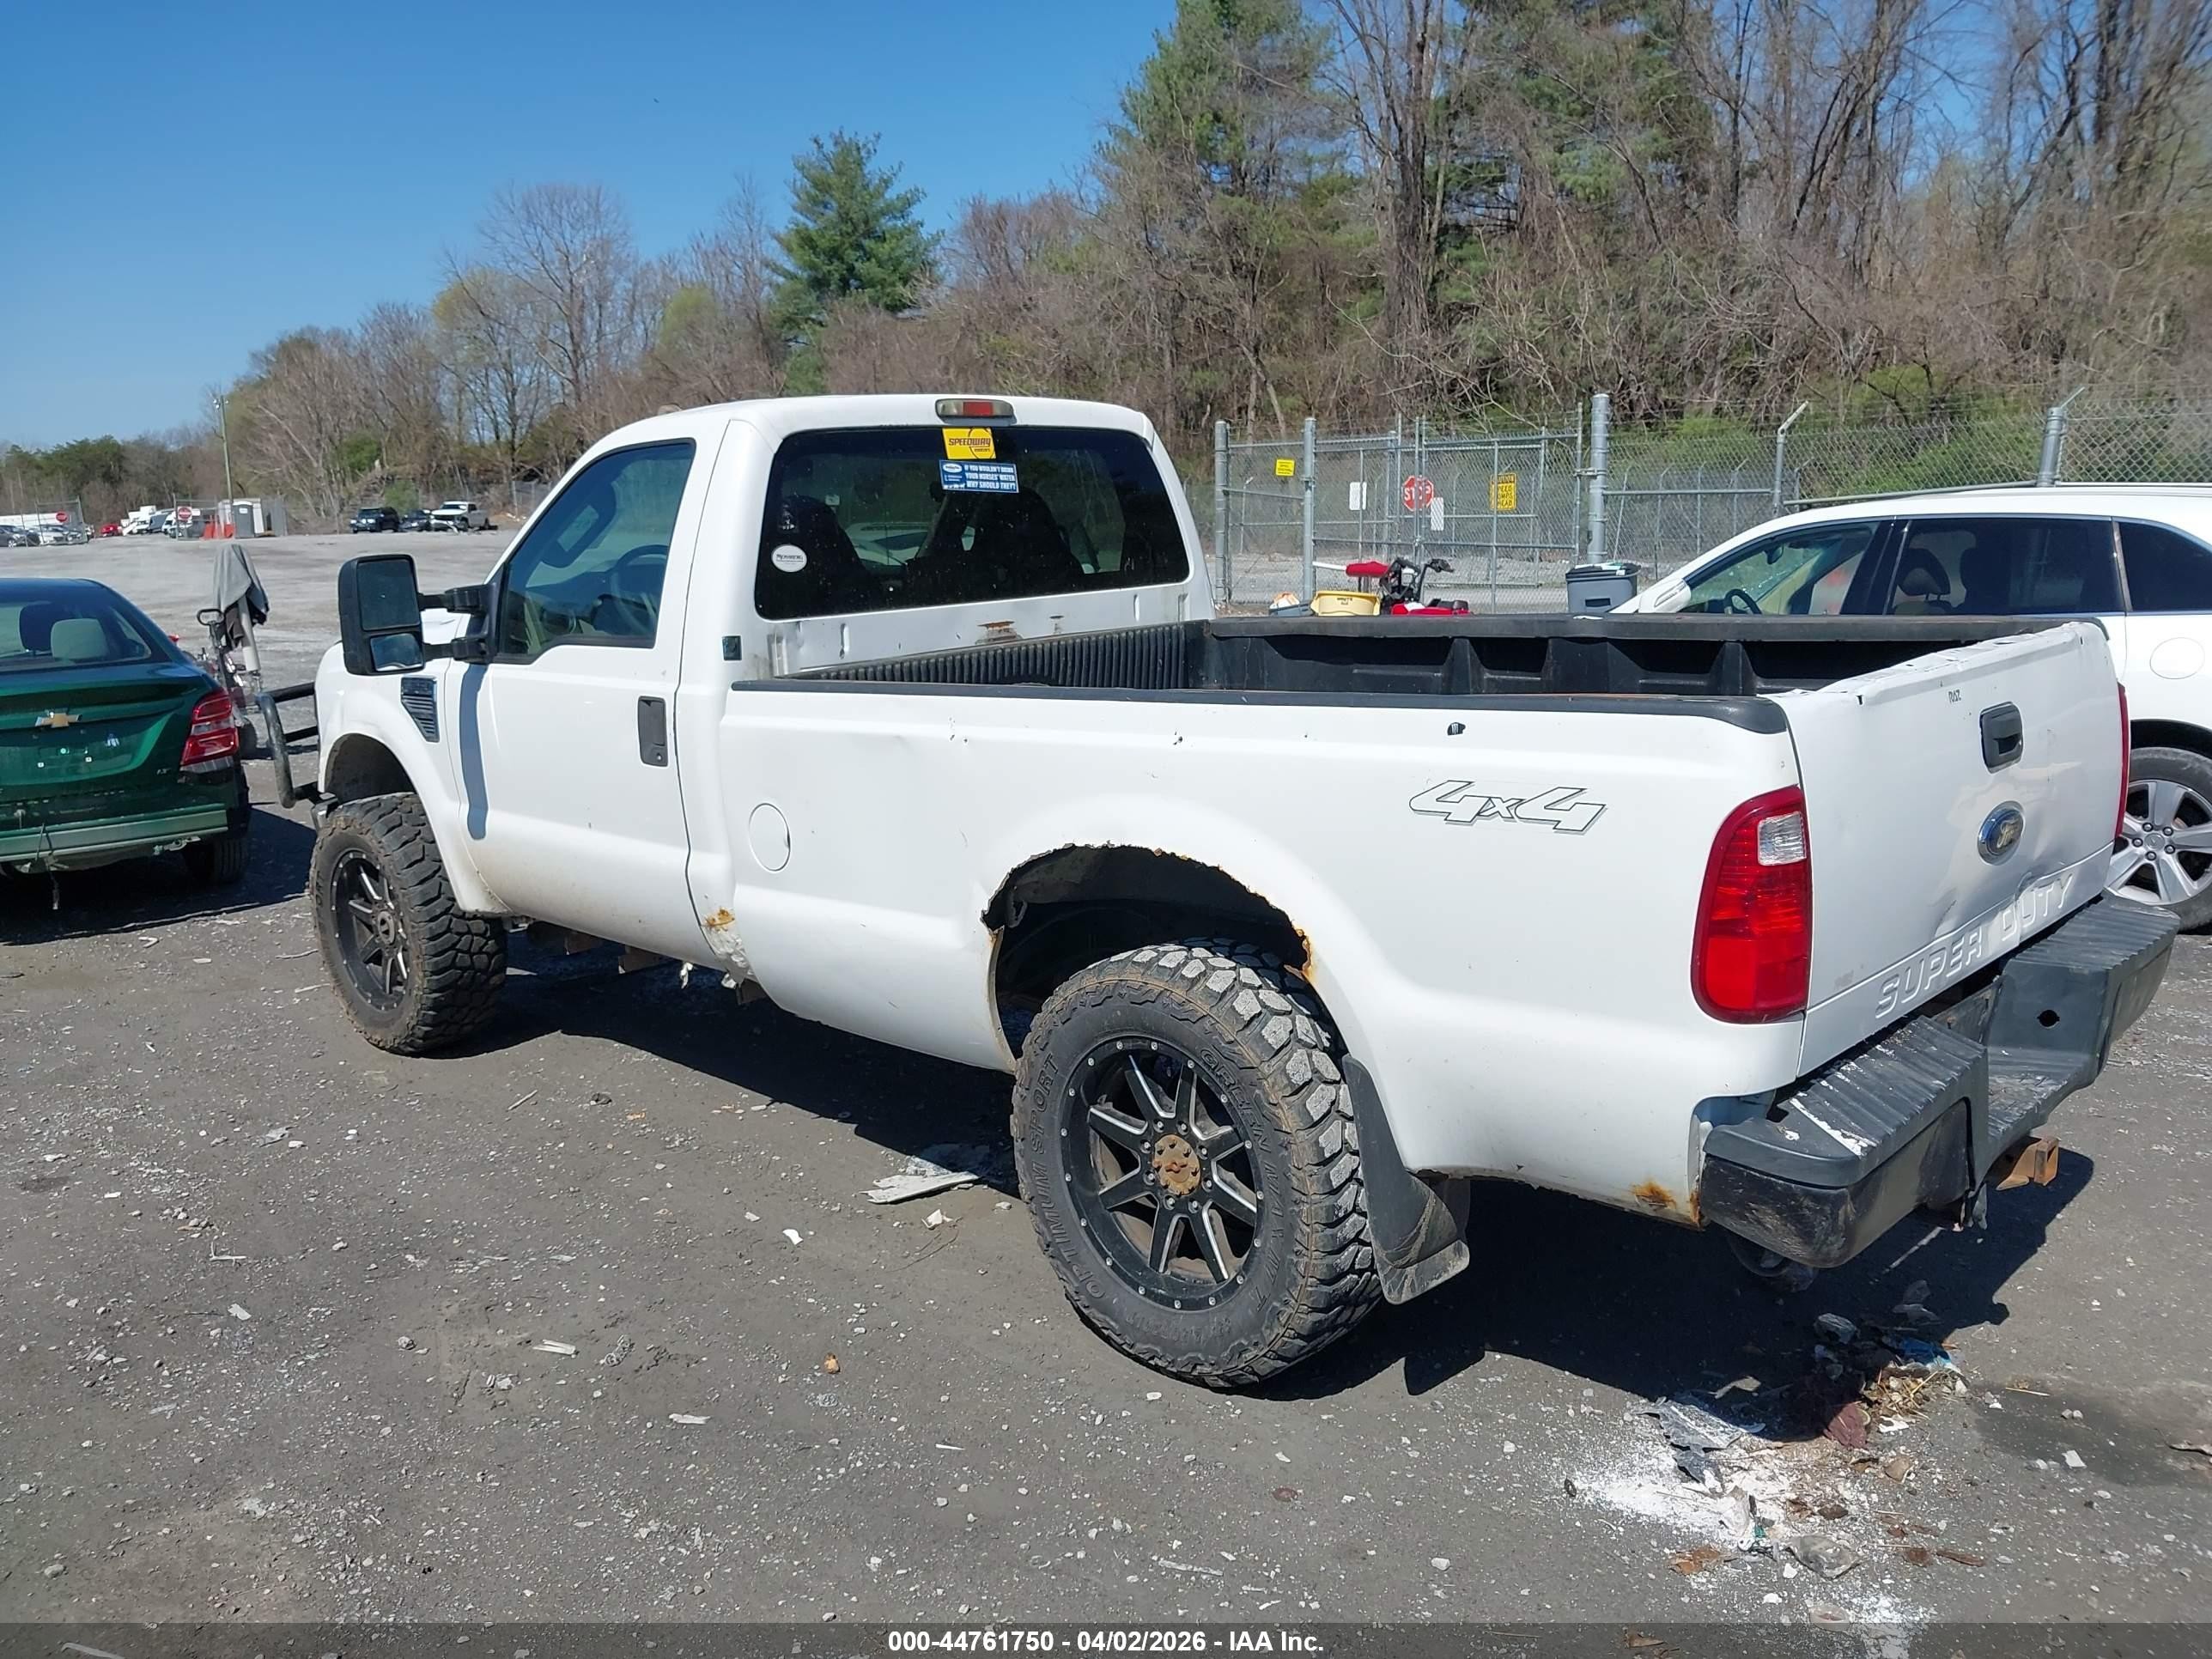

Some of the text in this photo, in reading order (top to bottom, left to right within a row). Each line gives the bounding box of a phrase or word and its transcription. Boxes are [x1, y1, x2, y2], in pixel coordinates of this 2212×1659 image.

[948, 438, 991, 448] SPEEDWAY
[1408, 780, 1607, 833] 4x4
[1875, 872, 2074, 1019] SUPER DUTY
[1030, 1052, 1059, 1155] SPORT
